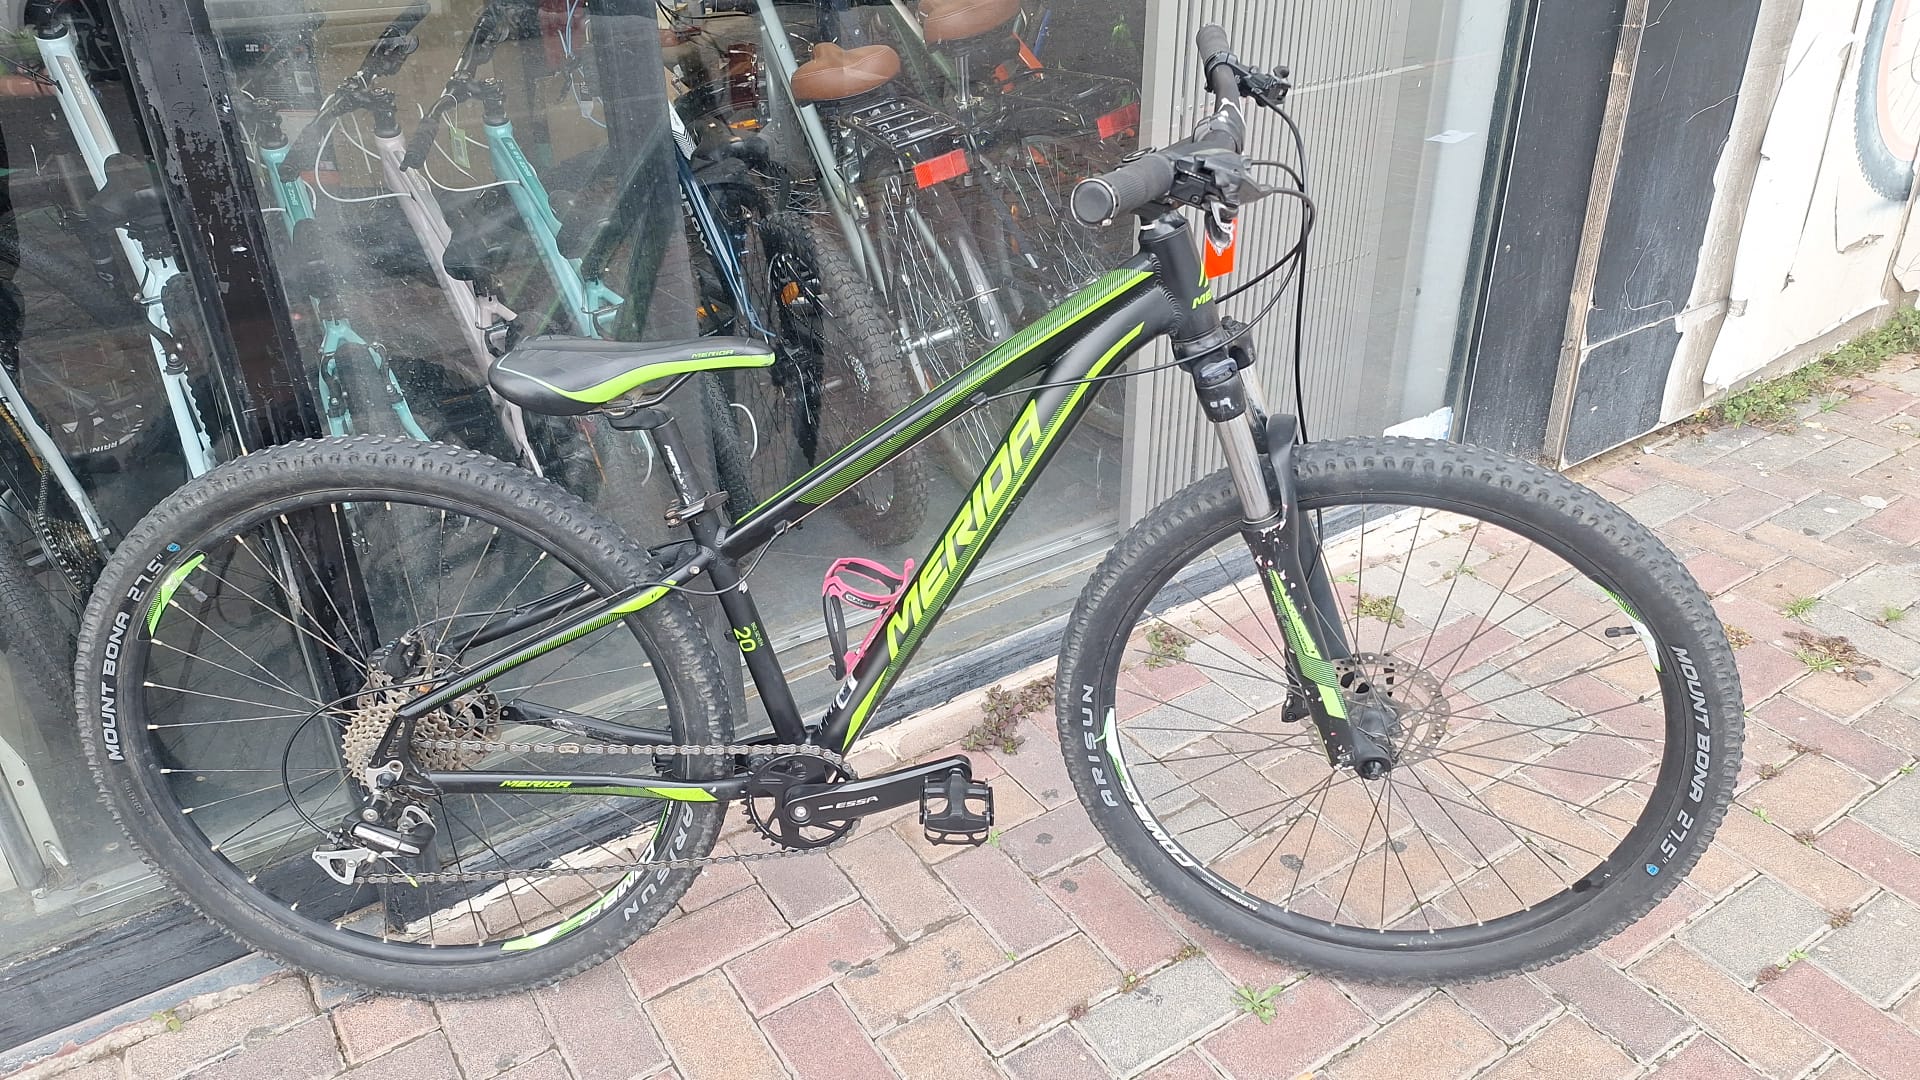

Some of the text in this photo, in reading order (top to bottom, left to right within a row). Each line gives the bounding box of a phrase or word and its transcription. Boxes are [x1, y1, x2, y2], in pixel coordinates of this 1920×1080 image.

[691, 349, 735, 359] MERIDA
[886, 398, 1042, 662] MERIDA
[103, 611, 131, 676] BONA
[733, 626, 757, 652] 20
[1670, 645, 1710, 729] MOUNT
[102, 681, 125, 761] MOUNT
[1082, 683, 1119, 808] ARISUN
[499, 779, 573, 788] MERIDA
[835, 795, 880, 809] ESSA
[1689, 734, 1711, 804] BONA
